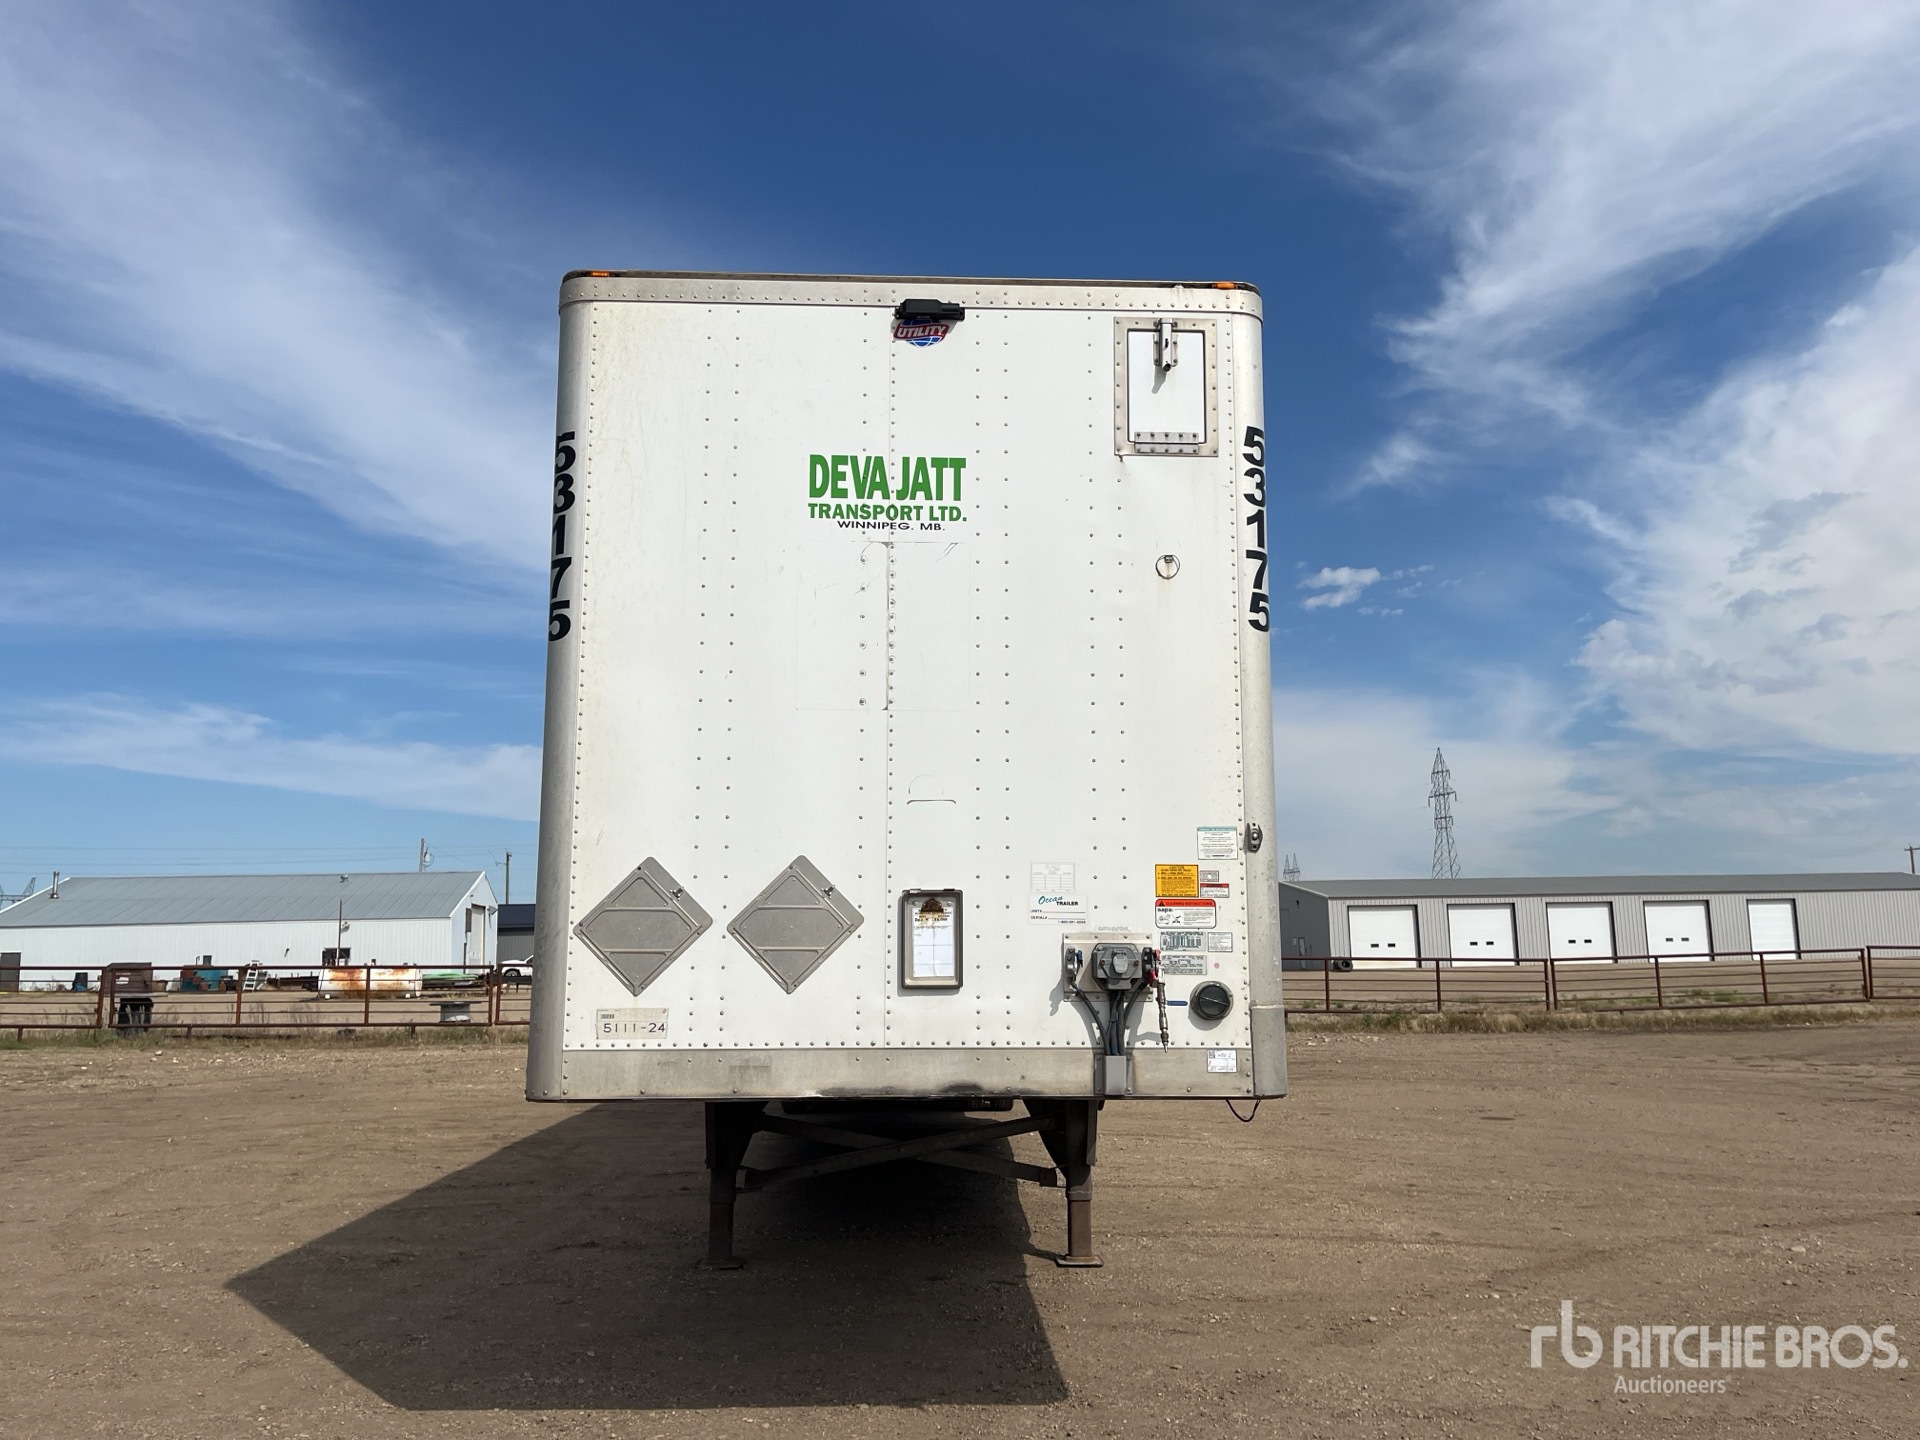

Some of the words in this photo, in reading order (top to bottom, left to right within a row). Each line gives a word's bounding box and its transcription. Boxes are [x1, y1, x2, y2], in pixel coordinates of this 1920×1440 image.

[897, 325, 946, 338] UTILITY
[808, 454, 891, 500] DEVA
[895, 456, 967, 501] JATT
[807, 503, 924, 521] TRANSPORT
[928, 505, 968, 522] LTD.
[549, 431, 576, 641] 53175
[919, 522, 946, 531] MB.
[1242, 426, 1270, 632] 53175
[603, 1022, 666, 1033] 5111-24
